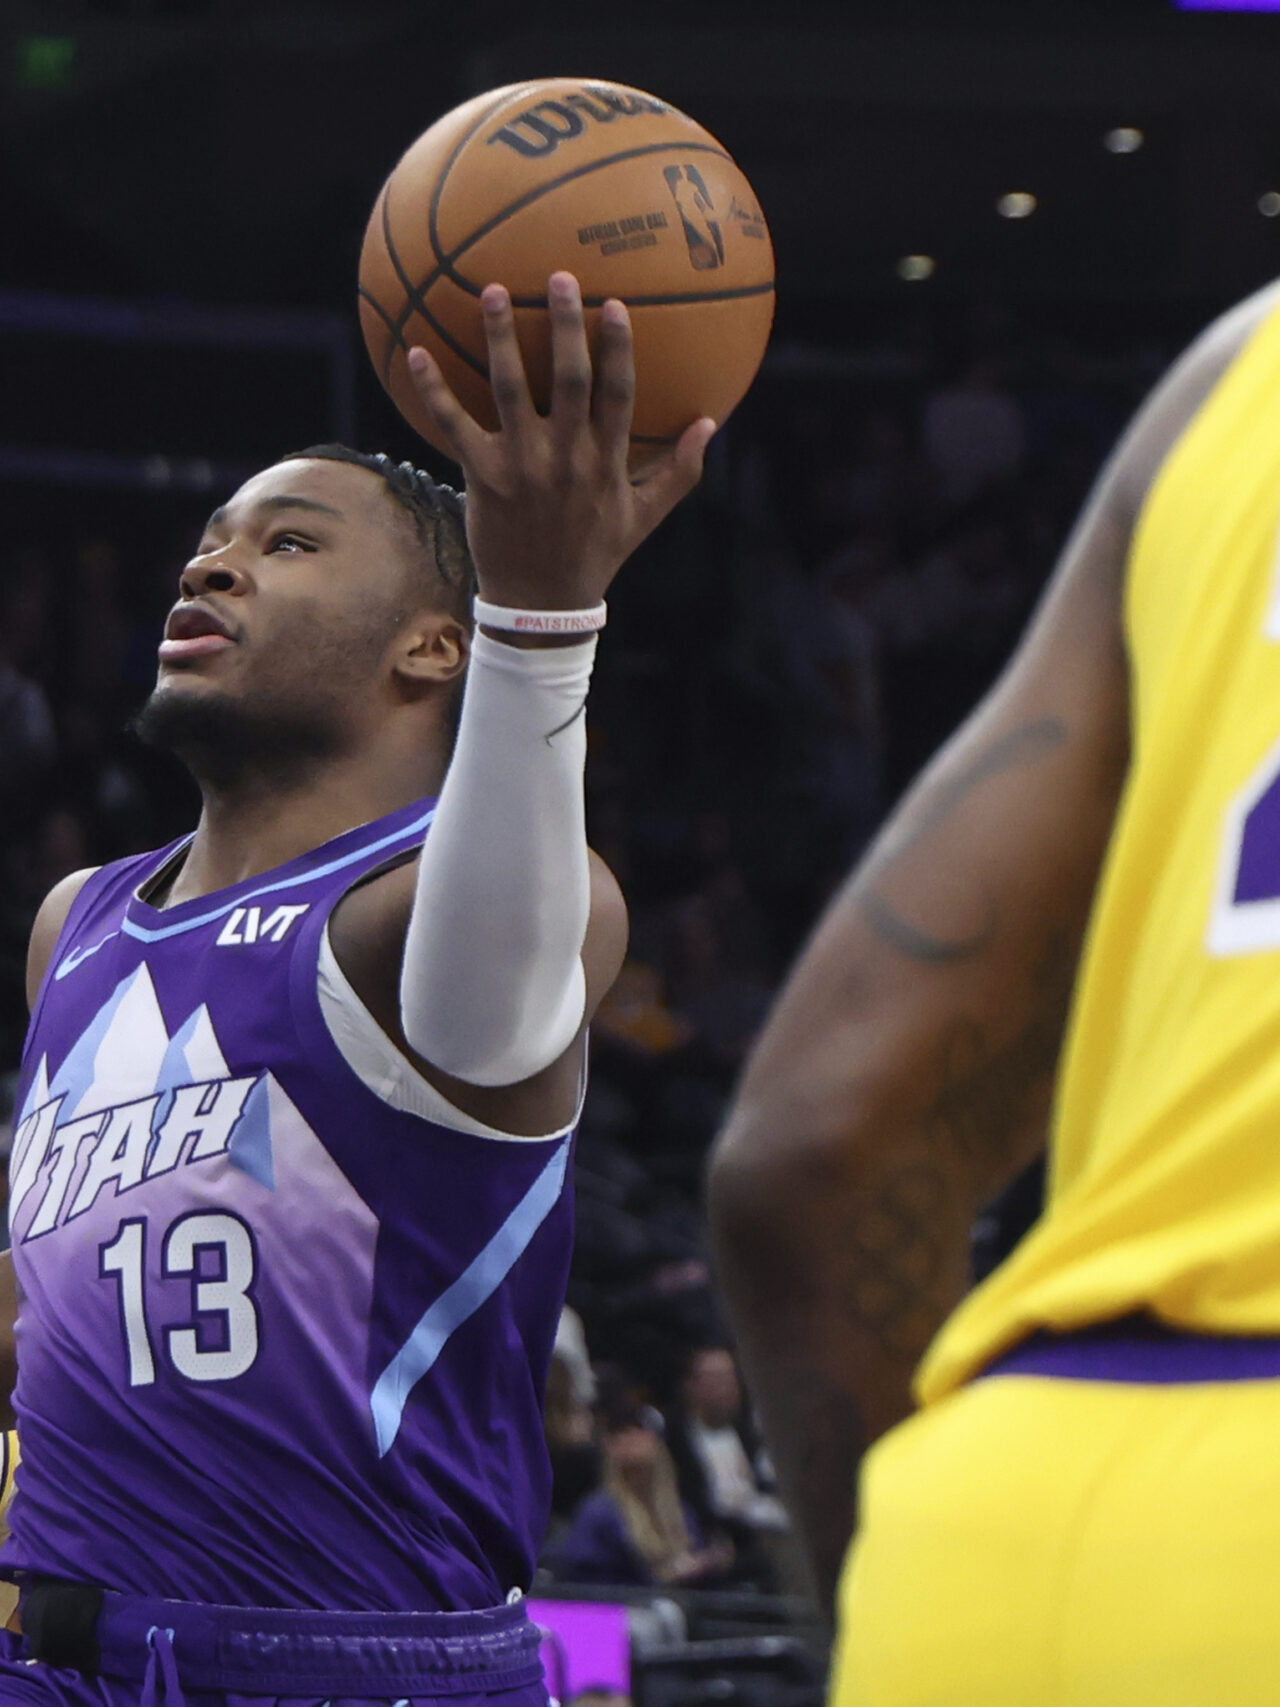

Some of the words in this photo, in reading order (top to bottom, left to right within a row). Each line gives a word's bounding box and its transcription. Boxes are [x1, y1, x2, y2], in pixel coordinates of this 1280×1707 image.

[215, 903, 311, 947] LVT
[8, 1076, 259, 1246] UTAH
[98, 1207, 262, 1389] 13
